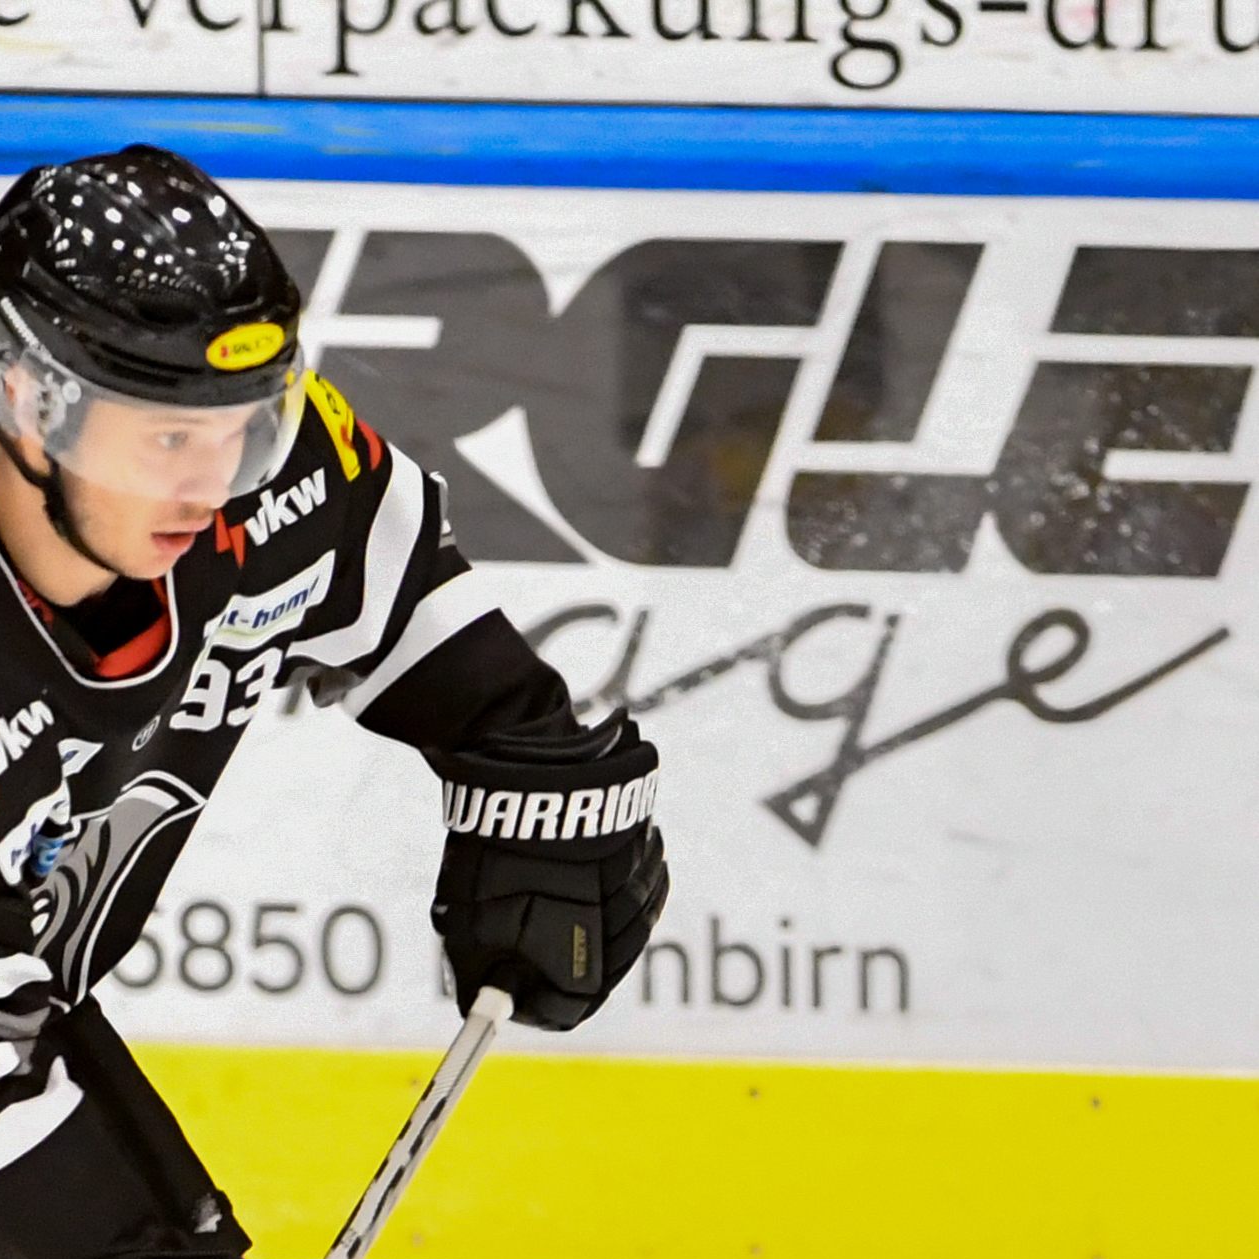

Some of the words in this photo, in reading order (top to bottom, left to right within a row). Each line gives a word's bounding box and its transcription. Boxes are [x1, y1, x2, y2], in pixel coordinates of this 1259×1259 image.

[244, 467, 327, 547] vkw
[219, 576, 319, 629] t-hom
[169, 646, 284, 732] 93
[443, 766, 658, 841] WARRIOR
[641, 916, 911, 1013] nbirn
